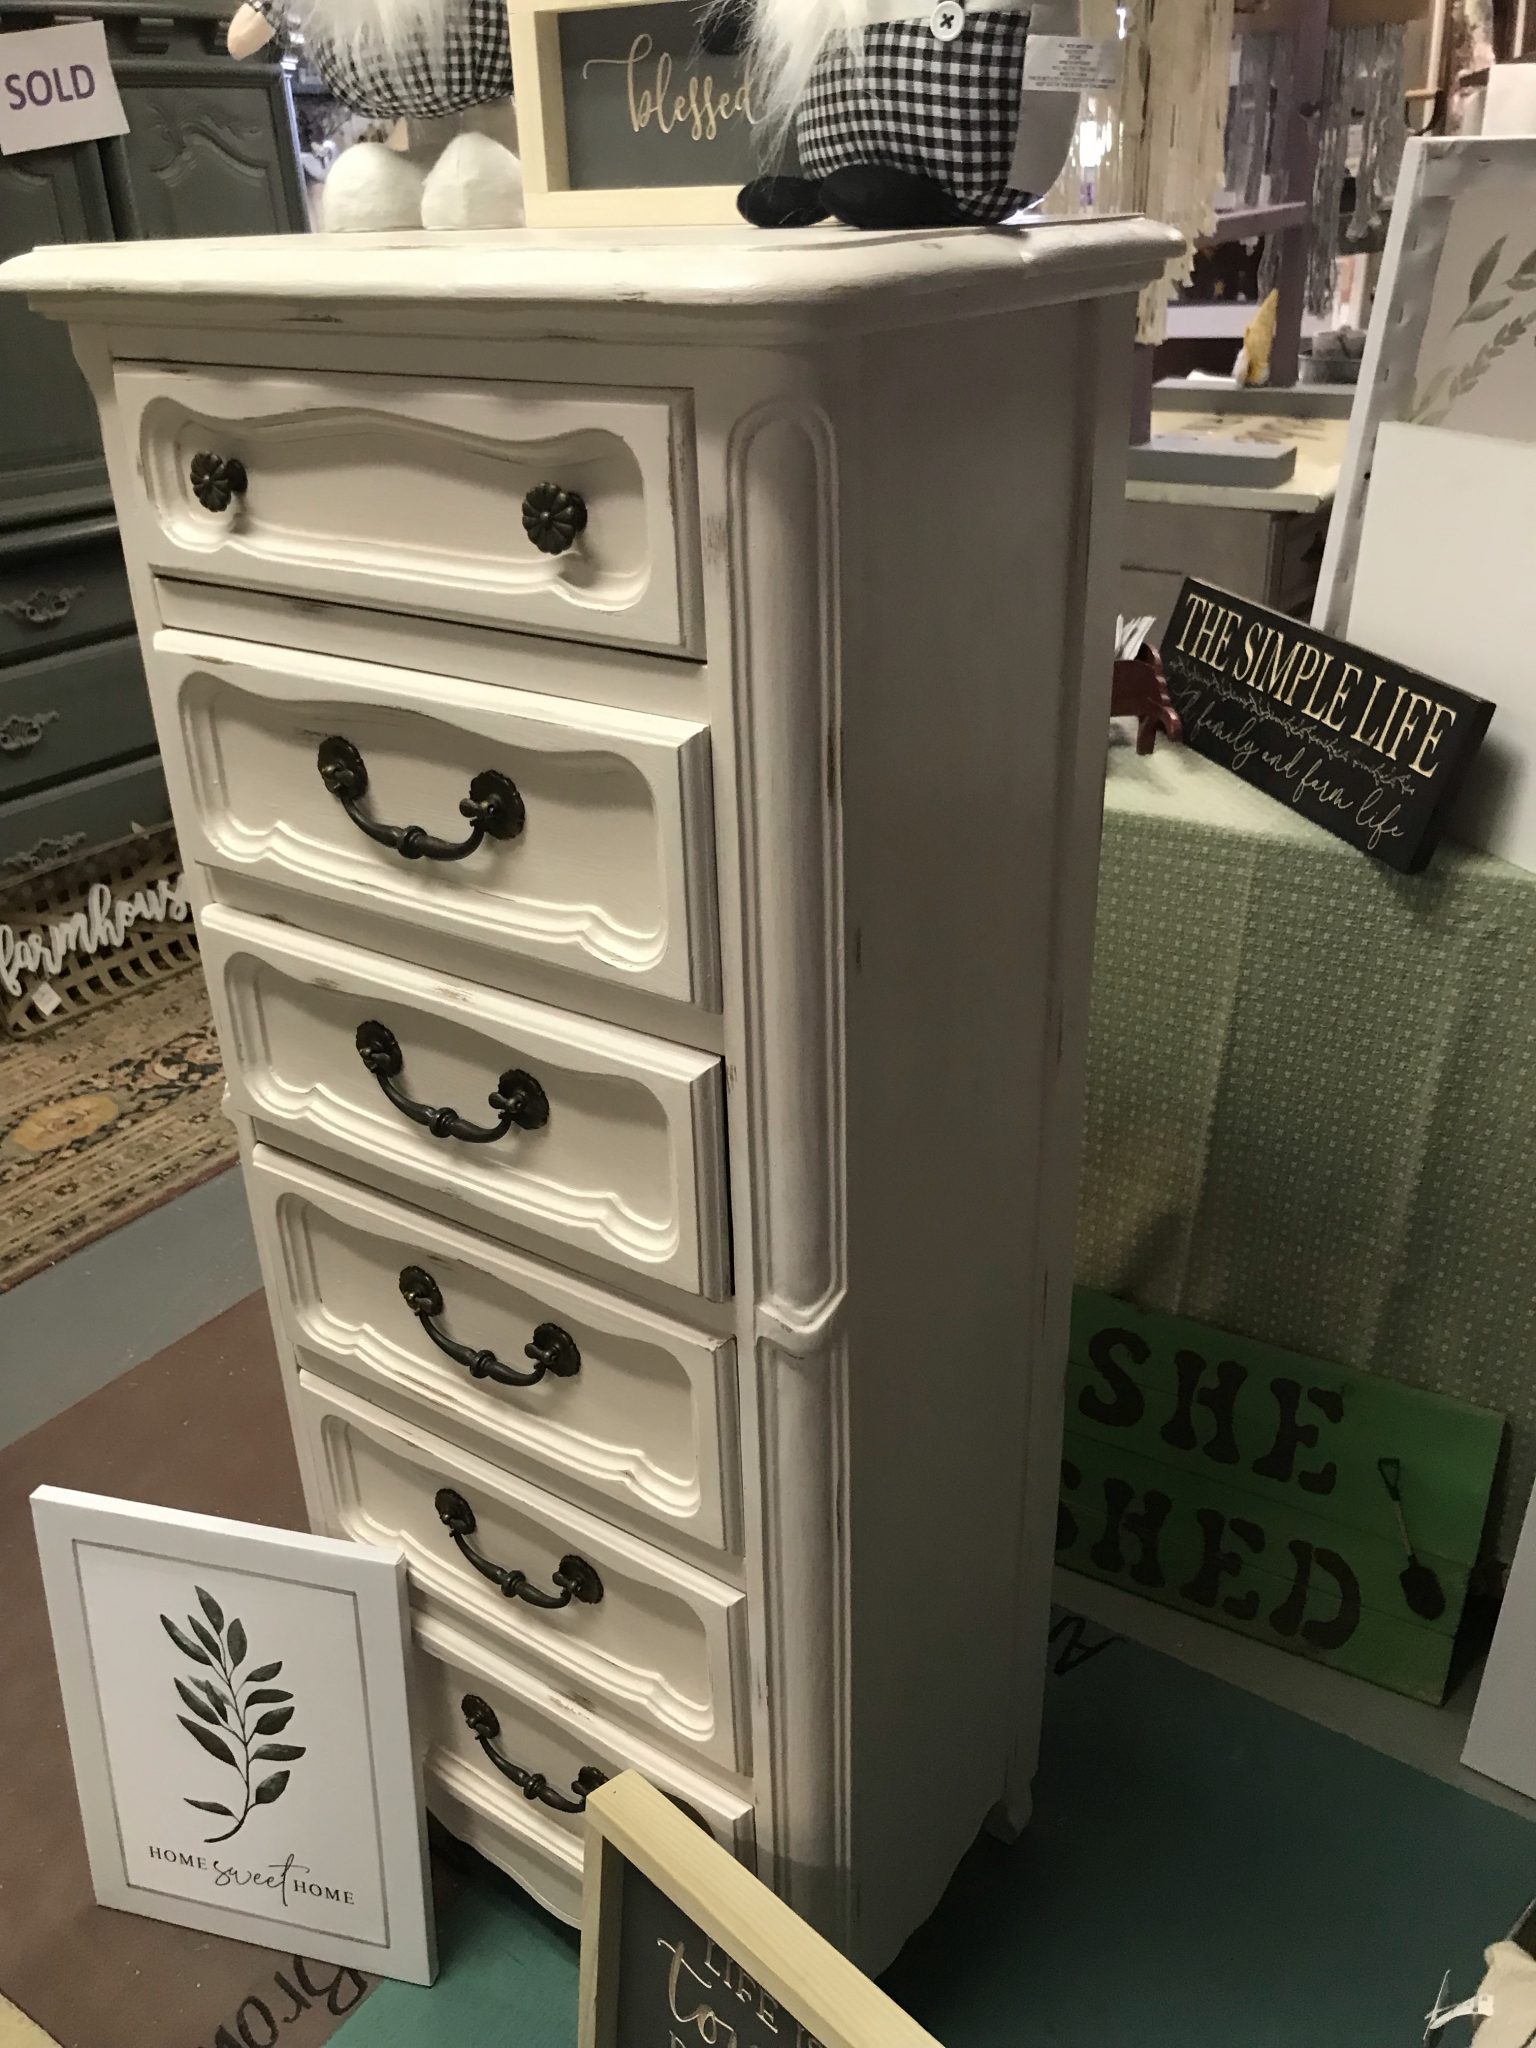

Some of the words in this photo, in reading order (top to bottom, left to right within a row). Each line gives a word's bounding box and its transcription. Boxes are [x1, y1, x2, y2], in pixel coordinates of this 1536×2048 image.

[4, 63, 96, 111] SOLD
[583, 33, 767, 141] blessed
[1175, 593, 1242, 672] THE
[1232, 621, 1363, 732] SIMPLE
[1350, 674, 1457, 779] LIFE
[1190, 700, 1260, 771] family
[1261, 746, 1307, 780] and
[1292, 759, 1355, 810] farm
[1355, 787, 1405, 850] life
[1078, 1327, 1345, 1495] SHE
[149, 1845, 208, 1871] HOME
[212, 1852, 311, 1908] sweet
[293, 1878, 356, 1906] HOME
